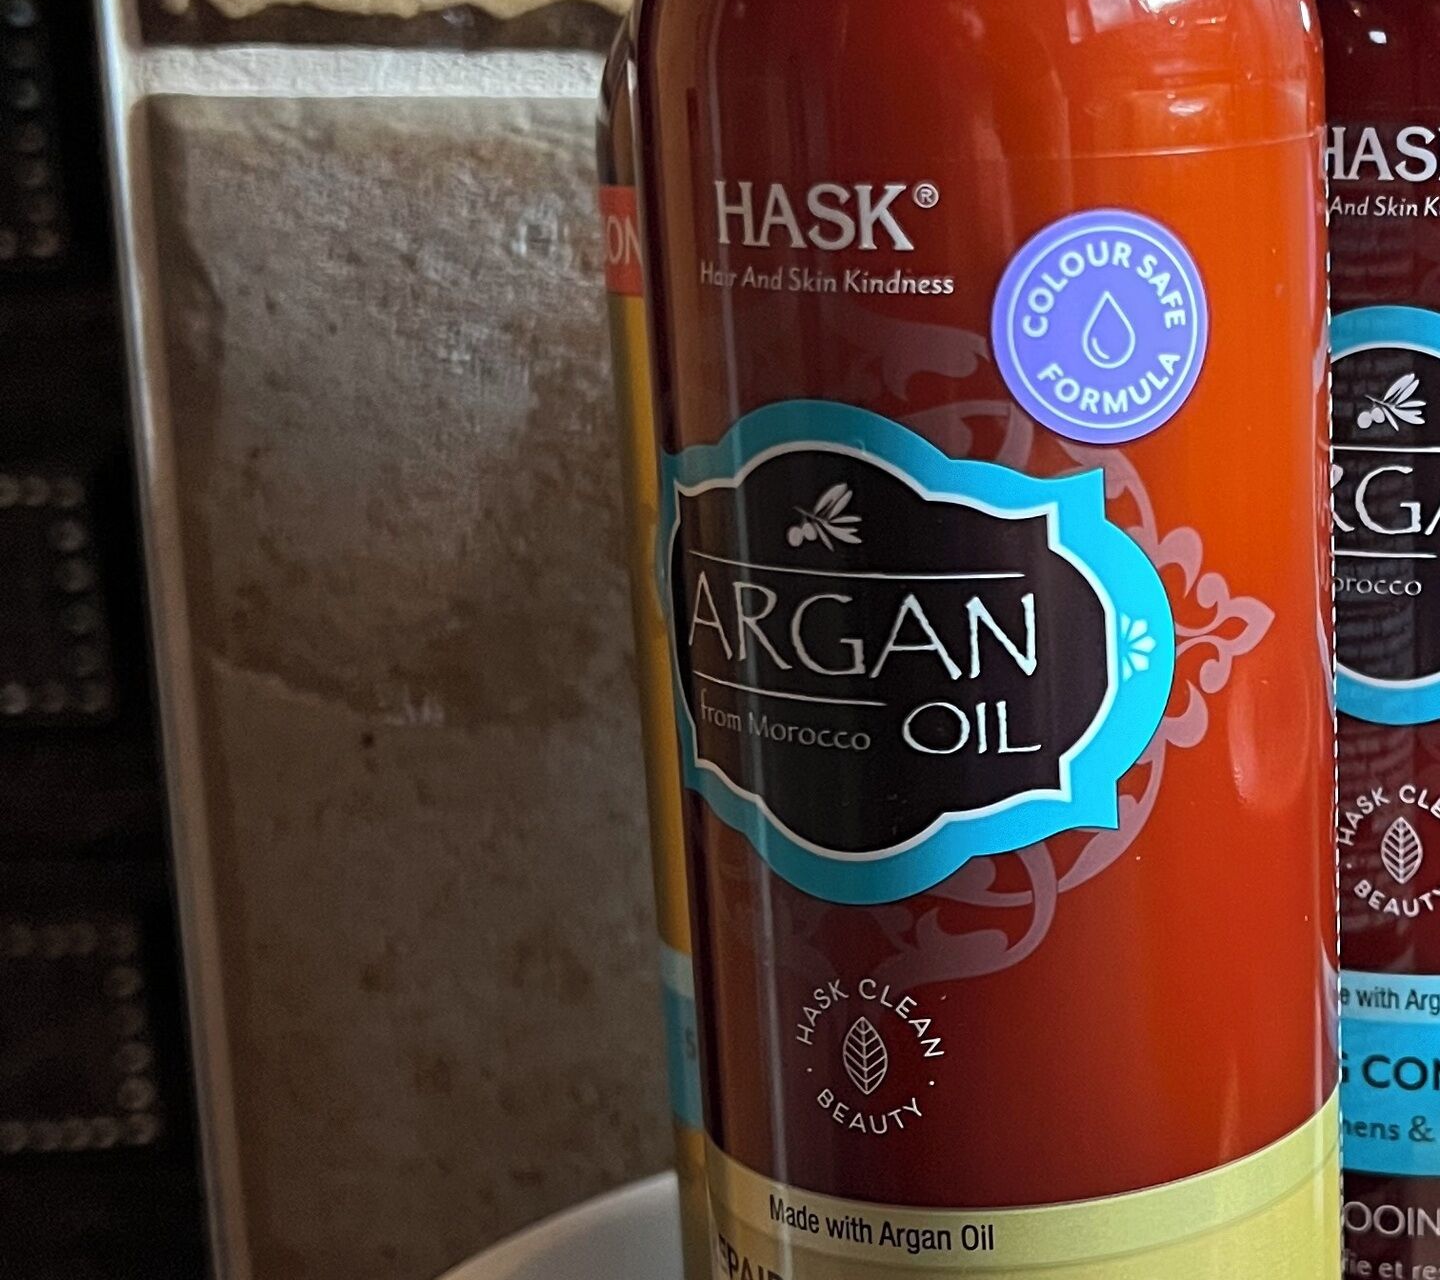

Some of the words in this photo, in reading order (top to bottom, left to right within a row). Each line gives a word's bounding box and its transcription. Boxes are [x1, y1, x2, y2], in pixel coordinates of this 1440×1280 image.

[1329, 197, 1367, 216] And
[1374, 196, 1418, 217] Skin
[700, 261, 736, 288] Hair
[742, 266, 782, 290] And
[789, 268, 836, 292] Skin
[844, 270, 954, 295] Kindness
[1022, 241, 1130, 338] COLOUR
[1136, 254, 1186, 329] SAFE
[1038, 351, 1180, 413] FORMULA
[1332, 575, 1422, 597] orocco
[689, 571, 1037, 680] ARGAN
[701, 688, 742, 733] from
[749, 710, 871, 751] Morocco
[903, 700, 1041, 754] OIL
[1338, 787, 1390, 846] HASK
[796, 979, 849, 1045] HASK
[859, 978, 944, 1057] CLEAN
[1356, 986, 1399, 1009] with
[817, 1088, 922, 1134] BEAUTY
[1408, 1116, 1434, 1142] &
[769, 1194, 820, 1234] Made
[825, 1216, 873, 1245] with
[879, 1221, 952, 1255] Argan
[961, 1223, 995, 1252] Oil
[1379, 1260, 1403, 1280] et
